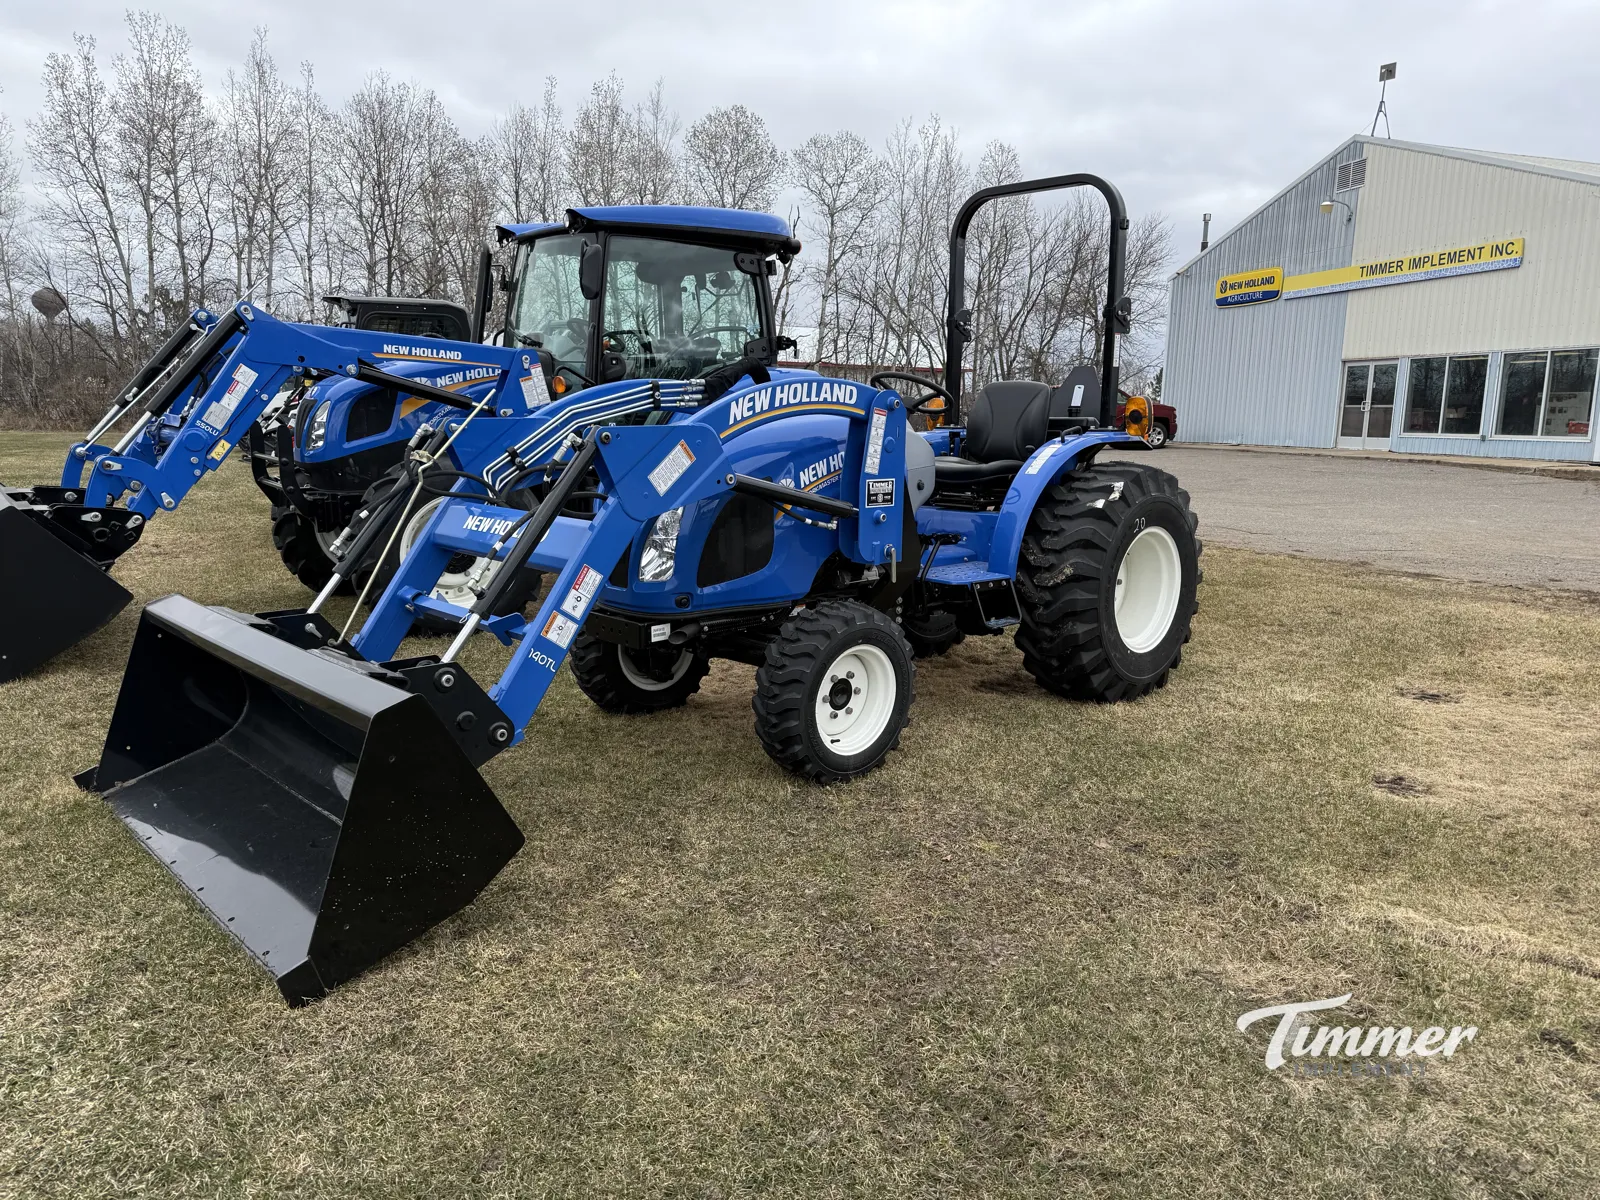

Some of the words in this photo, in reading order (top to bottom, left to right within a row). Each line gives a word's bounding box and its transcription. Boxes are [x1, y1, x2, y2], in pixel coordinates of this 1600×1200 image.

[1360, 259, 1404, 278] TIMMER
[1408, 246, 1485, 270] IMPLEMENT
[1490, 241, 1519, 258] INC.
[1228, 281, 1243, 291] NEW
[1244, 275, 1275, 288] HOLLAND
[1227, 291, 1263, 302] AGRICULTURE
[383, 344, 409, 355] NEW
[411, 347, 462, 360] HOLLAND
[436, 371, 464, 388] NEW
[466, 367, 501, 380] HOLLA
[728, 386, 772, 425] NEW
[774, 382, 857, 408] HOLLAND
[799, 458, 828, 489] NEW
[809, 475, 839, 495] ORKMASTER
[462, 514, 494, 532] NEW
[1134, 517, 1146, 533] 20
[528, 648, 556, 673] 140TL
